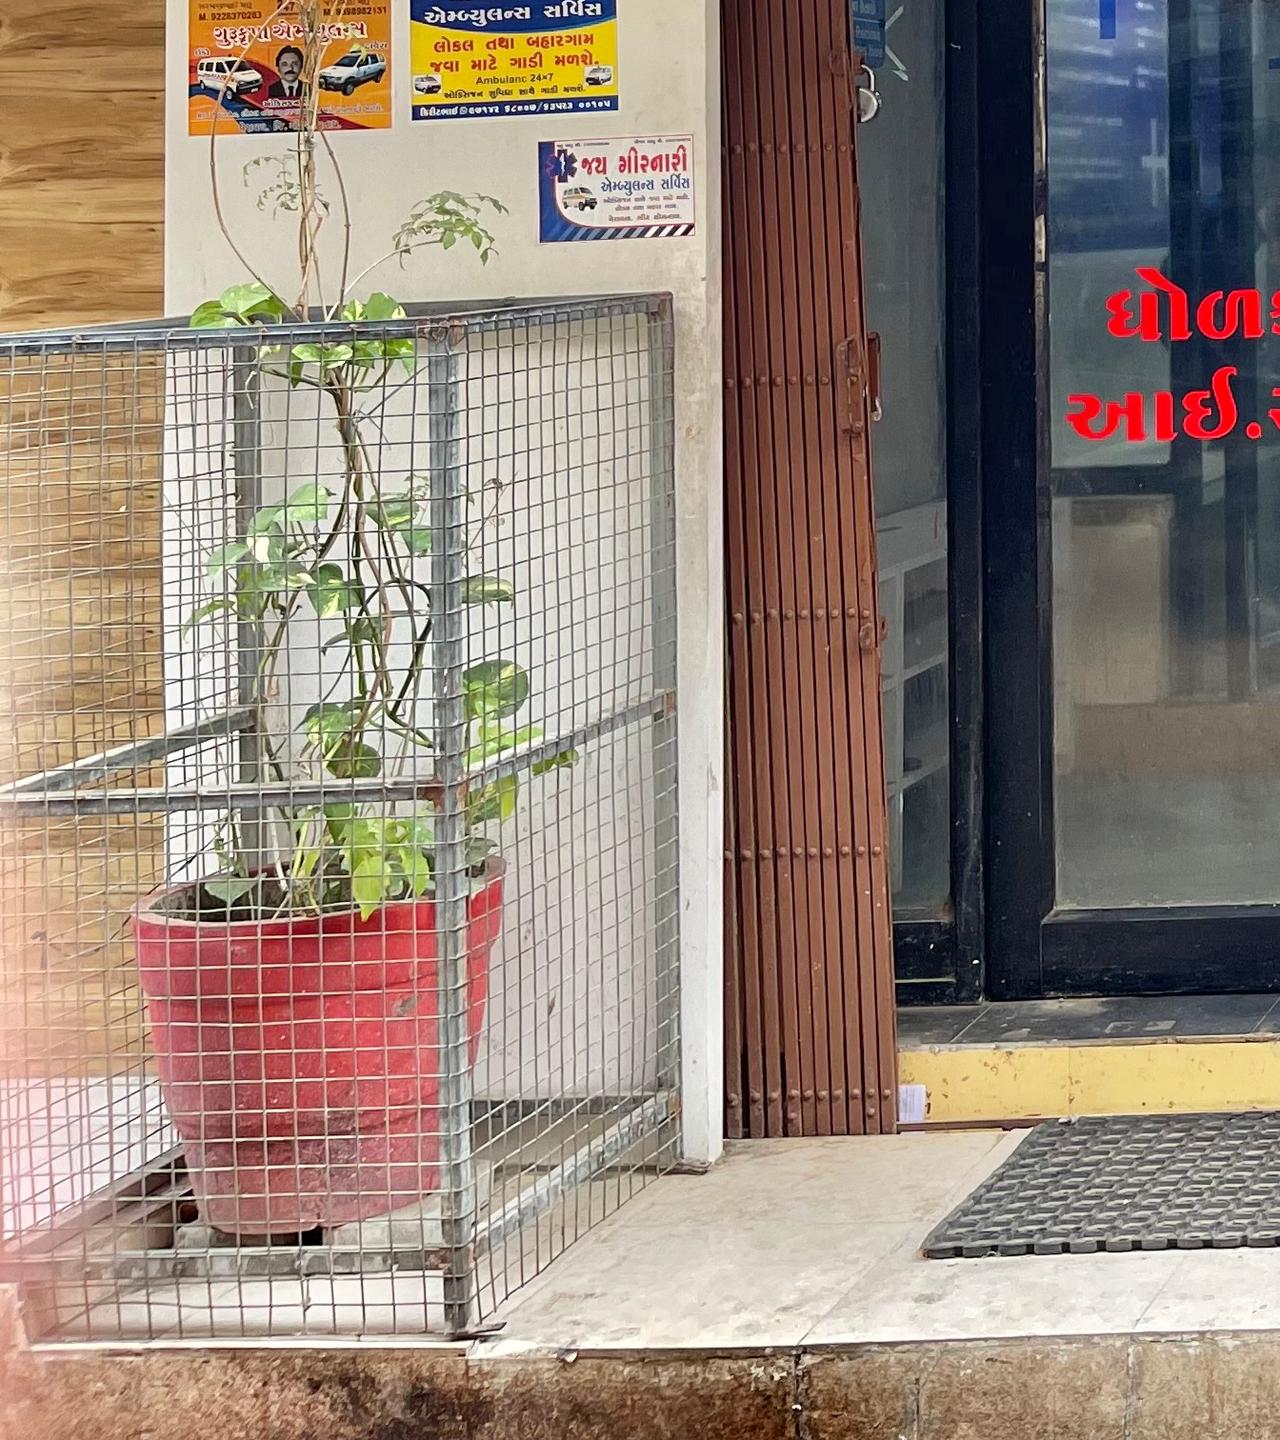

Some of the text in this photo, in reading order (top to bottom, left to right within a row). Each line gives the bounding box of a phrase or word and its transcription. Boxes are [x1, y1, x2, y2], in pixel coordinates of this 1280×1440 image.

[424, 5, 531, 27] એમ્બ્યુલન્સ
[433, 32, 594, 53] લોકલ તથા બહારગામ
[429, 48, 600, 74] જવા માટે ગાડી મળશે.
[581, 144, 688, 175] જય ગીરનારી
[600, 173, 691, 197] એમ્બ્યુલન્સ સર્વિસ
